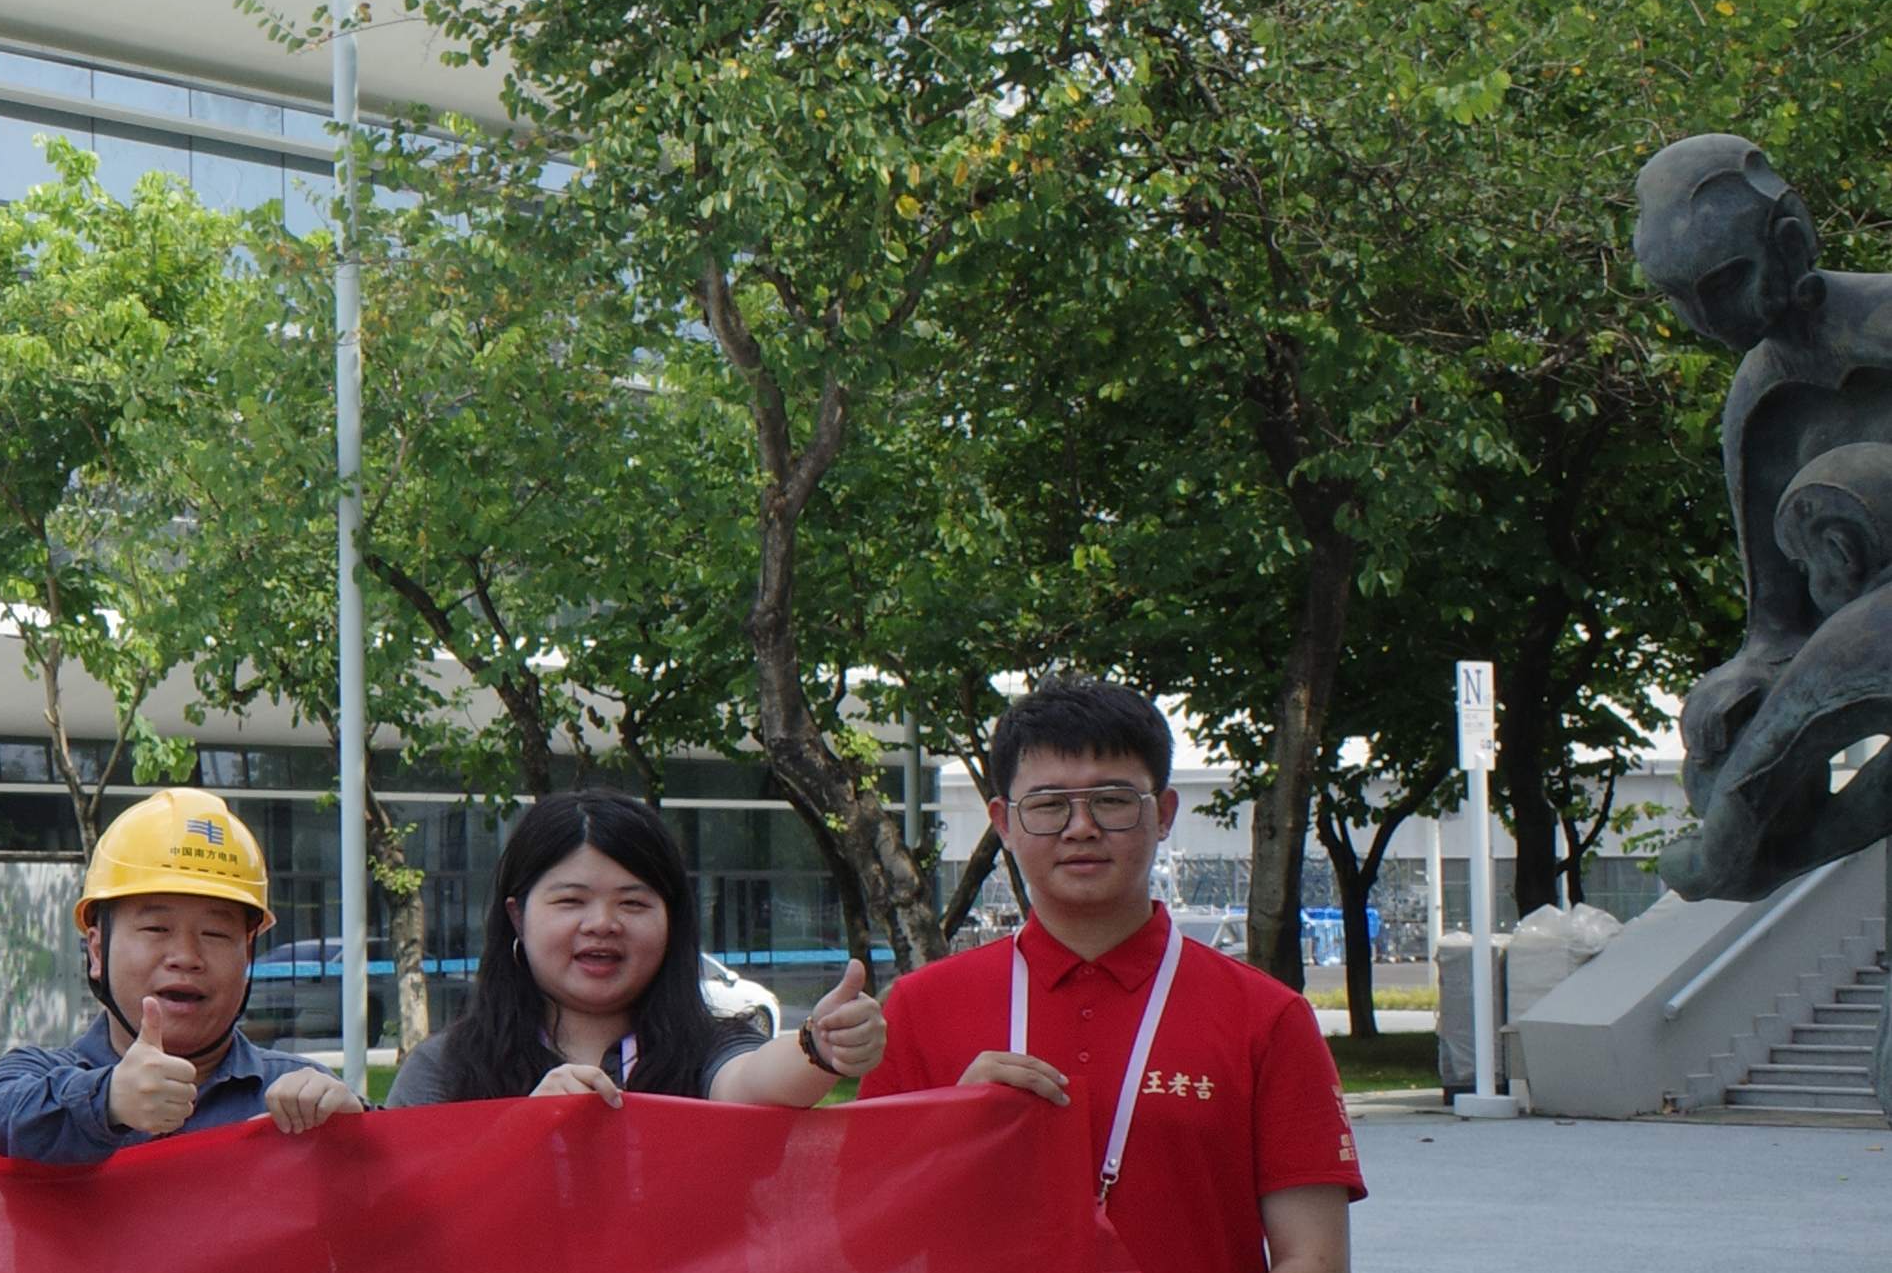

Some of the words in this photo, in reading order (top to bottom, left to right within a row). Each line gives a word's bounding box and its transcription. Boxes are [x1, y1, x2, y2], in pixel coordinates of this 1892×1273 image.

[169, 846, 239, 865] 中国南方电网
[1141, 1070, 1216, 1101] 王老吉
